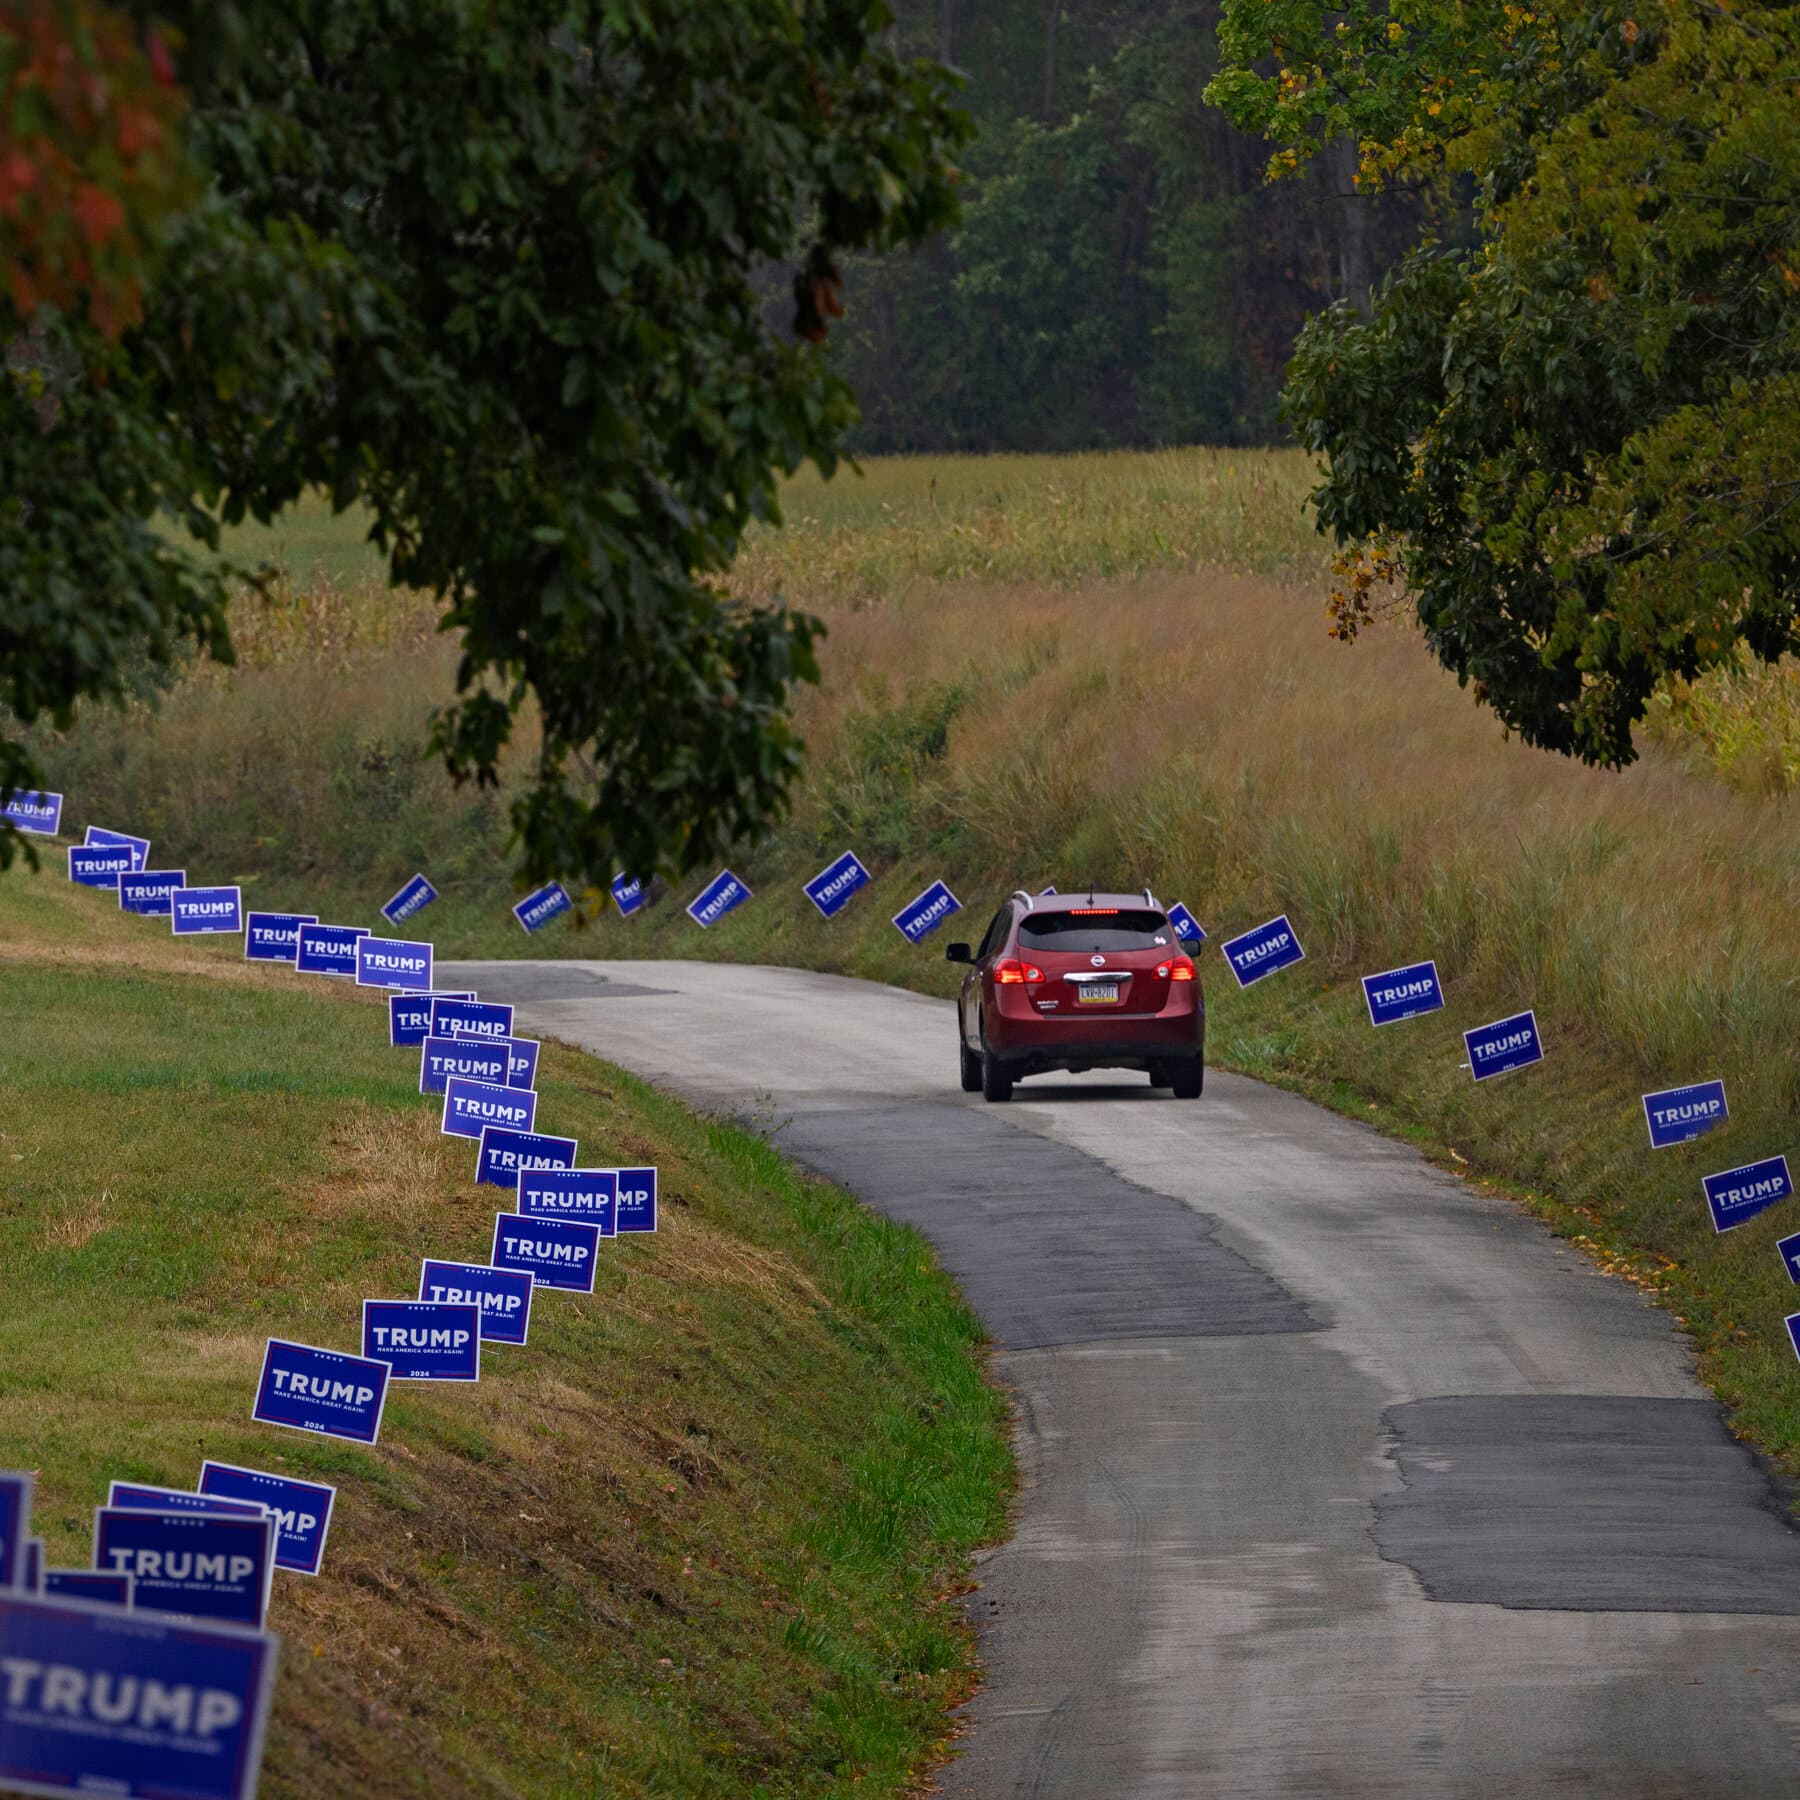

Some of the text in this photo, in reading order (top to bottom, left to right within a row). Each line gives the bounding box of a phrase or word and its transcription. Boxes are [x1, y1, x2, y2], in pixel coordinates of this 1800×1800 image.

[75, 860, 128, 872] TRUMP
[615, 881, 641, 899] TRU
[816, 865, 858, 903] TRUMP
[178, 902, 234, 915] TRUMP
[392, 885, 429, 920] TRUMP
[523, 892, 563, 923] TRUMP
[700, 882, 738, 921] TRUMP
[906, 895, 949, 934] TRUMP
[253, 928, 299, 942] TRUM
[364, 953, 426, 970] TRUMP
[1234, 933, 1289, 966] TRUMP
[1372, 979, 1433, 1004] TRUMP
[397, 1013, 430, 1026] TRU
[438, 1017, 505, 1036] TRUMP
[1474, 1030, 1532, 1058] TRUMP
[430, 1057, 502, 1075] TRUMP
[454, 1097, 527, 1122] TRUMP
[1653, 1100, 1720, 1124] TRUMP
[488, 1149, 566, 1169] TRUMP
[527, 1191, 609, 1208] TRUMP
[1715, 1177, 1784, 1207] TRUMP
[504, 1237, 588, 1262] TRUMP
[522, 1256, 544, 1264] AMERICA
[430, 1285, 521, 1312] TRUMP
[373, 1328, 470, 1348] TRUMP
[272, 1368, 374, 1405] TRUMP
[274, 1390, 365, 1413] MAKE AMERICA GREAT AGAIN!
[304, 1421, 325, 1430] 2024
[284, 1533, 308, 1542] AGAIN!
[109, 1548, 255, 1583] TRUMP
[1, 1657, 243, 1737] TRUMP
